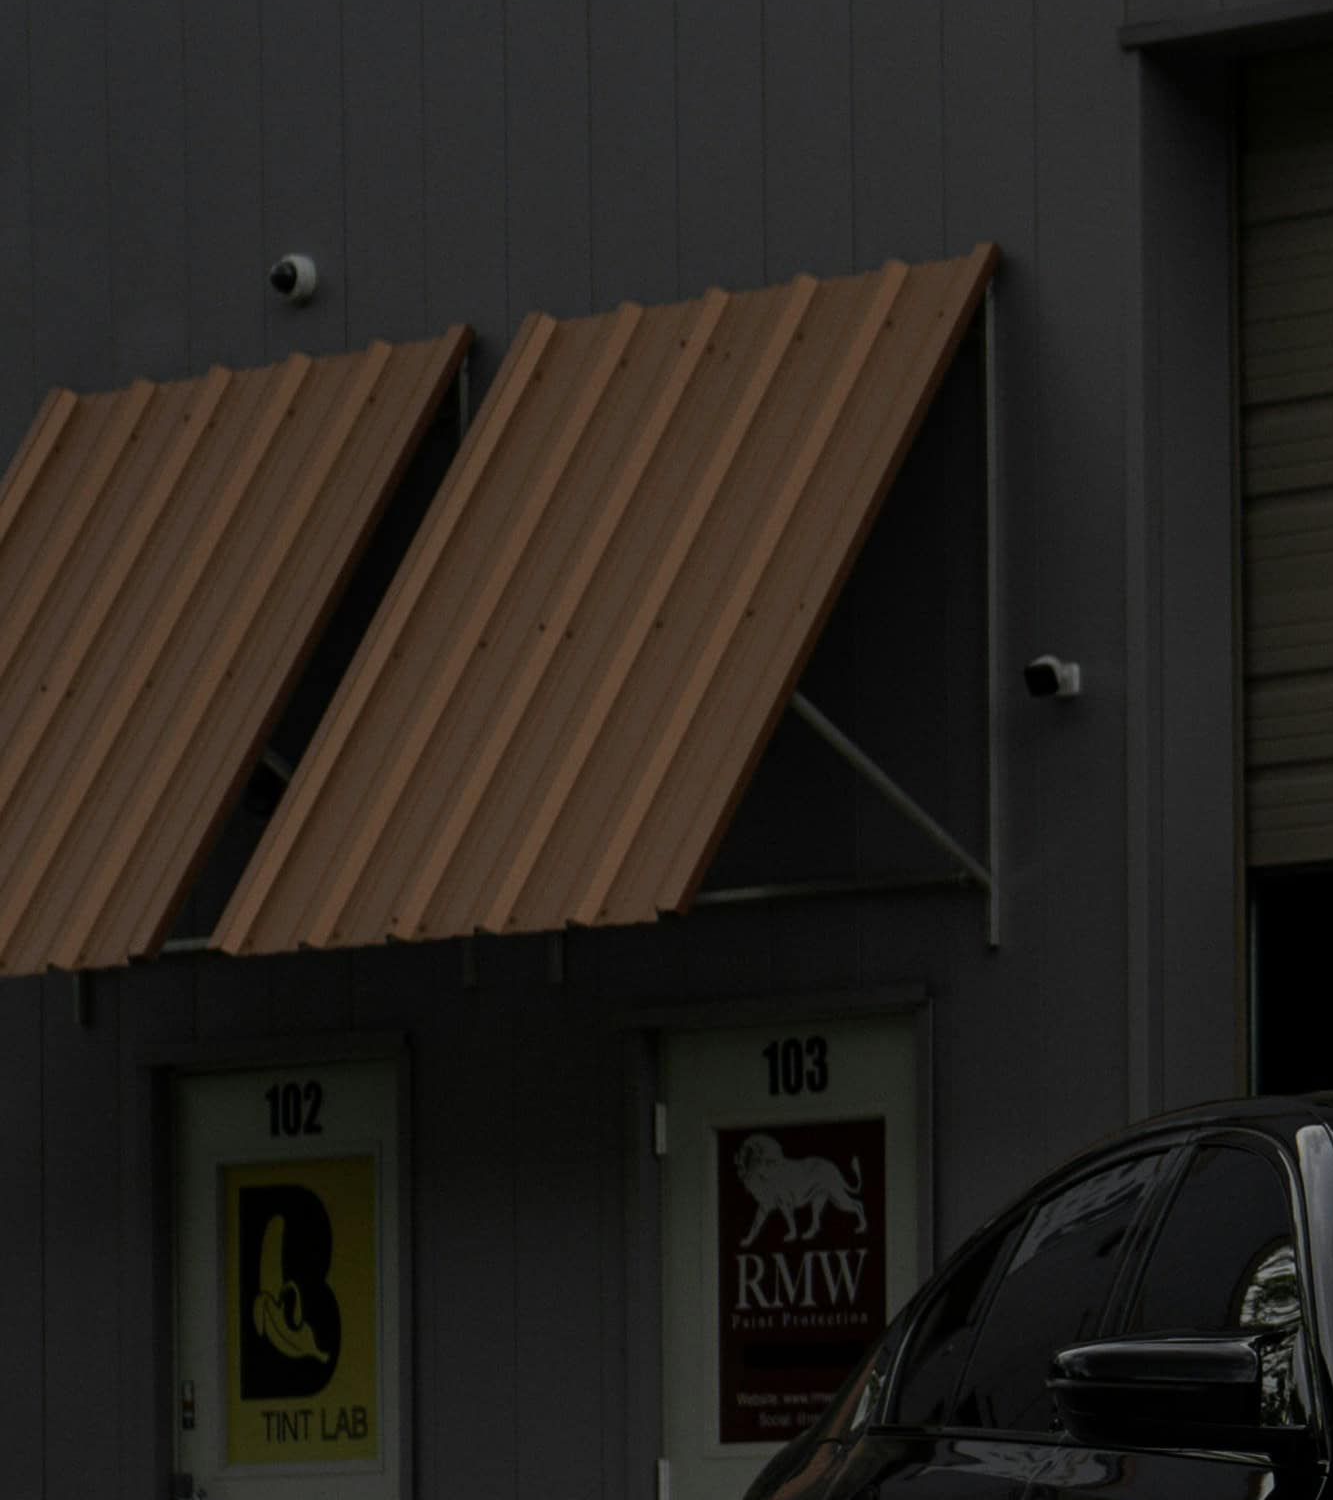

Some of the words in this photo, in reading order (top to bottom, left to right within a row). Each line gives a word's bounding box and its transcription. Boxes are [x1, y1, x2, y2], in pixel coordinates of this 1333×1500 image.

[762, 1035, 828, 1096] 103
[265, 1081, 323, 1136] 102
[734, 1248, 868, 1311] RMW
[730, 1313, 774, 1331] Paint
[780, 1308, 868, 1328] Protection
[260, 1408, 314, 1444] TINT
[320, 1405, 369, 1442] LAB
